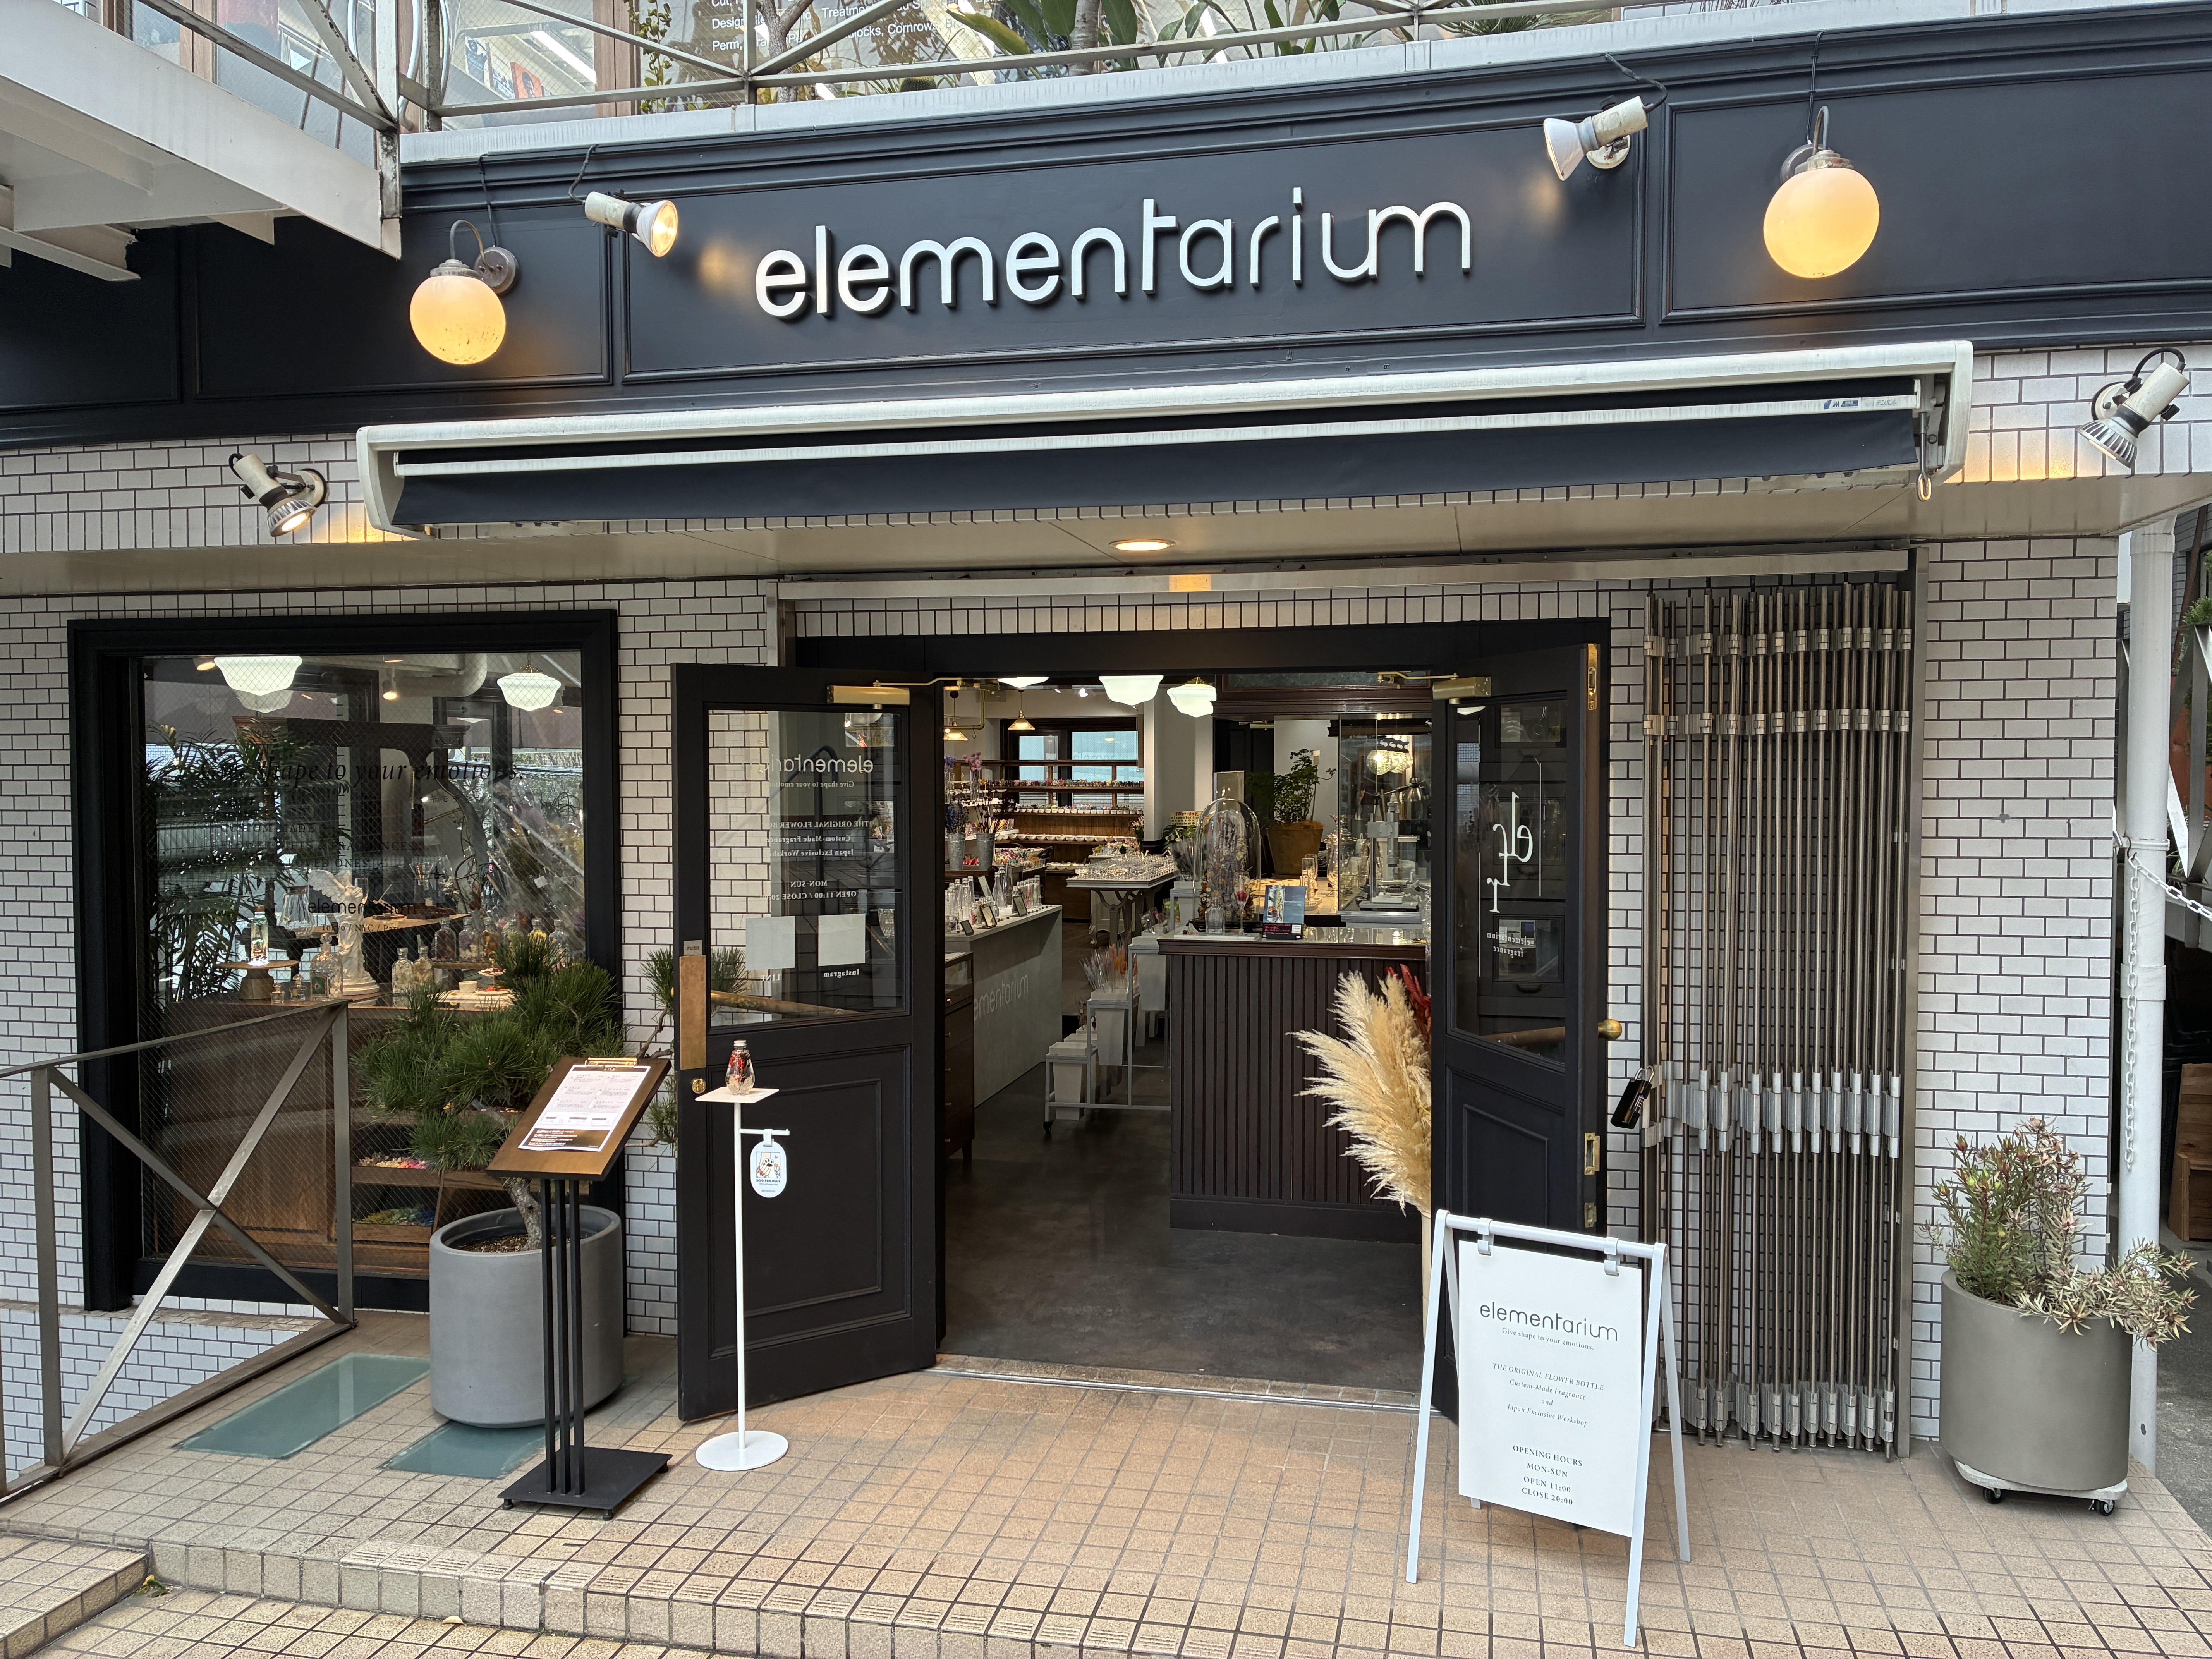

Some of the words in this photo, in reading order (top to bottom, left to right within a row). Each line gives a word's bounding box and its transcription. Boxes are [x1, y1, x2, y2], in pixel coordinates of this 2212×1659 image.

[821, 6, 866, 18] Treatme
[713, 40, 742, 51] Perm,
[755, 187, 1472, 320] elementarium
[260, 756, 318, 788] hape
[326, 760, 346, 780] to
[352, 764, 407, 788] your
[416, 759, 523, 780] emotios.
[277, 840, 312, 850] IFTS
[335, 859, 368, 867] ONES
[974, 971, 1029, 1021] ementarium
[1480, 1302, 1618, 1341] elementarium
[1502, 1328, 1516, 1336] Give
[1518, 1330, 1536, 1341] shape
[1562, 1340, 1594, 1350] emotions.
[1492, 1362, 1507, 1371] THE
[1509, 1365, 1543, 1379] ORIGINAL
[1545, 1373, 1574, 1385] FLOWER
[1576, 1379, 1604, 1391] BOTTLE
[1510, 1379, 1553, 1394] Custom-Made
[1554, 1388, 1586, 1400] Fragrance
[1507, 1404, 1525, 1413] Japan
[1527, 1408, 1555, 1419] Exclusive
[1557, 1414, 1588, 1427] Workshop
[1513, 1445, 1551, 1460] OPENING
[1554, 1454, 1582, 1467] HOURS
[1527, 1462, 1568, 1478] MON-SUN
[1523, 1476, 1546, 1487] OPEN
[1549, 1482, 1571, 1493] 11:00
[1522, 1487, 1549, 1499] CLOSE
[1551, 1494, 1573, 1505] 20:00
